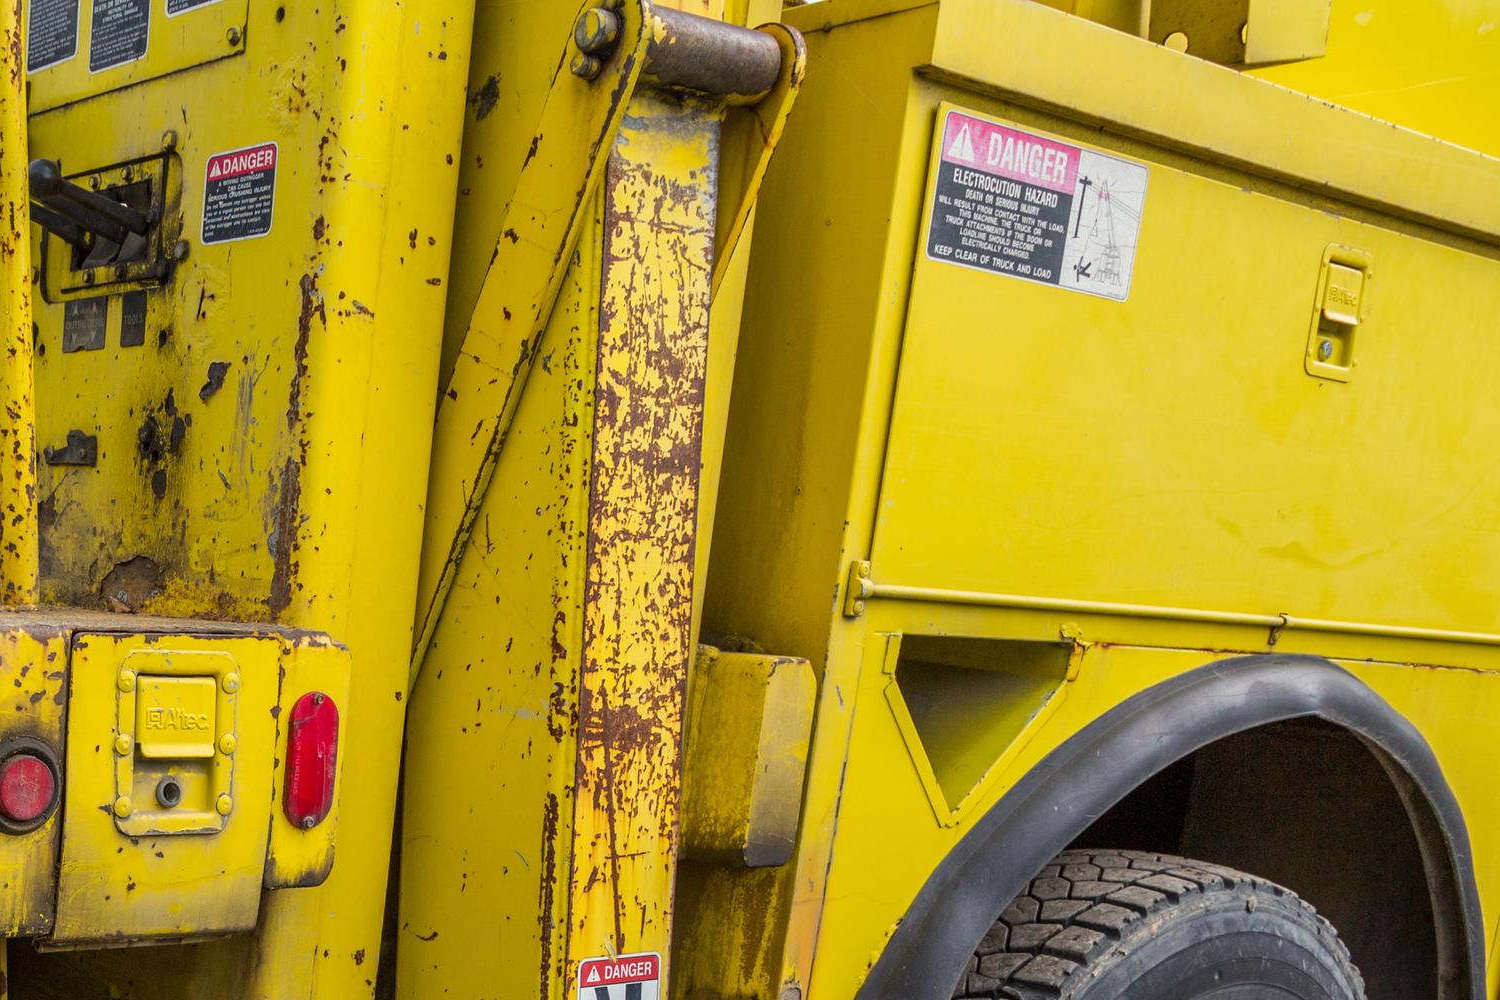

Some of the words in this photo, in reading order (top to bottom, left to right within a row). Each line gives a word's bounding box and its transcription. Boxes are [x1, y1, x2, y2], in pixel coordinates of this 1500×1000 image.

[223, 150, 273, 174] DANGER
[987, 132, 1068, 185] DANGER
[953, 168, 1022, 199] ELECTROCUTION
[1024, 187, 1058, 208] HAZARD
[939, 194, 952, 205] WILL
[954, 198, 975, 210] RESULT
[977, 204, 993, 214] FROM
[994, 208, 1020, 221] CONTACT
[1022, 215, 1035, 225] WITH
[1037, 219, 1047, 229] THE
[965, 189, 983, 201] DEATH
[985, 194, 994, 204] OR
[995, 196, 1018, 210] SERIOUS
[1020, 202, 1040, 216] INJURY
[945, 215, 964, 226] TRUCK
[965, 219, 1005, 236] ATTACHMENTS
[1014, 232, 1025, 241] THE
[1026, 235, 1043, 245] BOOM
[959, 209, 972, 219] THIS
[1001, 219, 1012, 229] THE
[1014, 222, 1032, 233] TRUCK
[1034, 227, 1042, 235] OR
[959, 228, 987, 241] LOADLINE
[988, 234, 1010, 245] SHOULD
[1012, 240, 1035, 252] BECOME
[961, 237, 1001, 254] ELECTRICALLY
[934, 244, 953, 256] KEEP
[955, 249, 978, 261] CLEAR
[980, 255, 990, 264] OF
[992, 257, 1015, 270] TRUCK
[1016, 264, 1031, 274] AND
[1033, 267, 1051, 279] LOAD
[164, 707, 209, 731] Altec
[605, 962, 652, 980] DANGER
